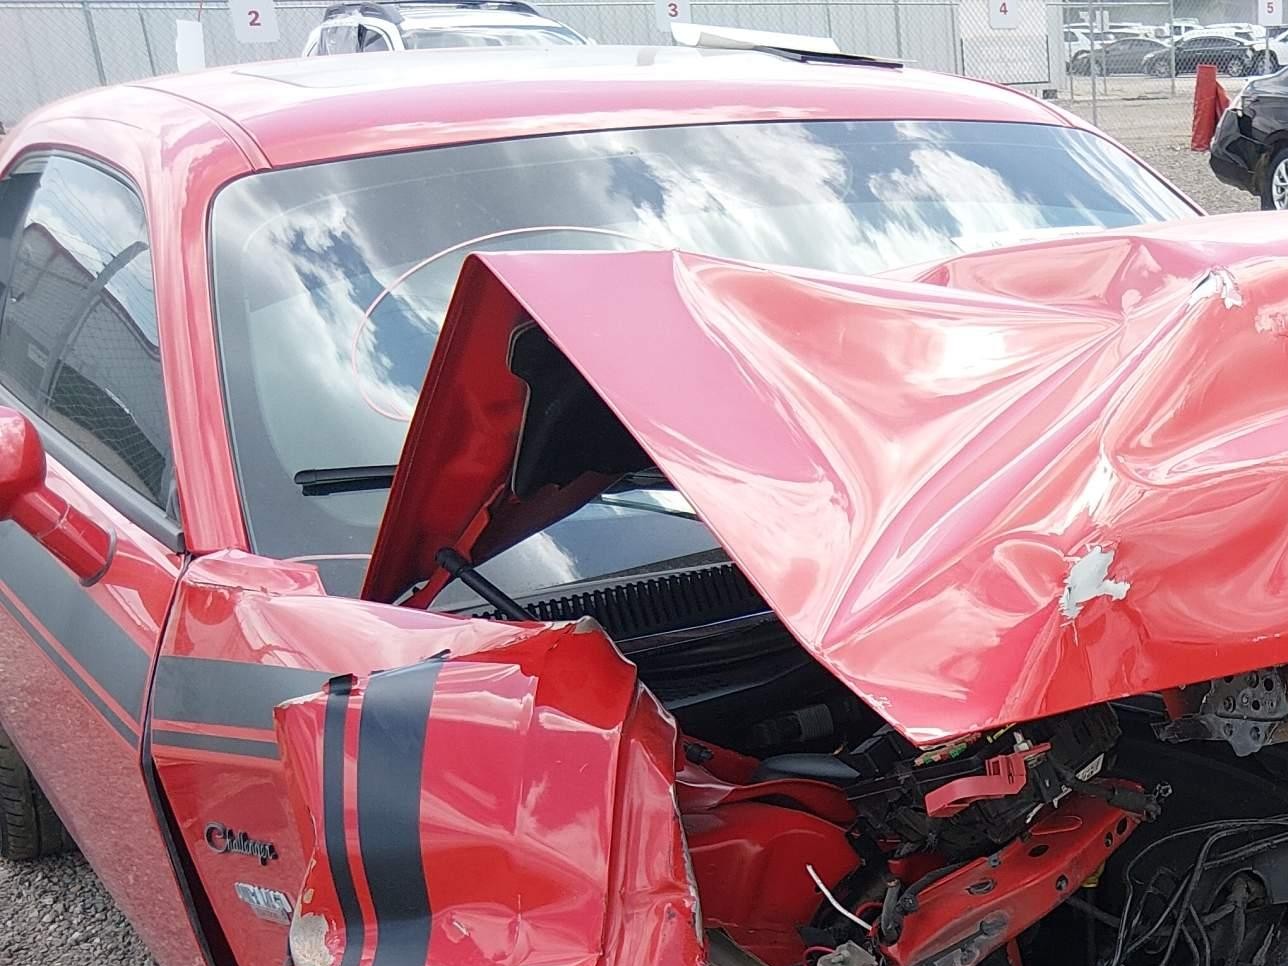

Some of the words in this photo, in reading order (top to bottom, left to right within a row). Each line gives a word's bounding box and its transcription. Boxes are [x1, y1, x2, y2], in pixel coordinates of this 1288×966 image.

[668, 3, 679, 17] 3
[1000, 2, 1008, 15] 4
[1267, 2, 1273, 13] 5
[248, 11, 261, 26] 2
[204, 821, 278, 866] Challenger
